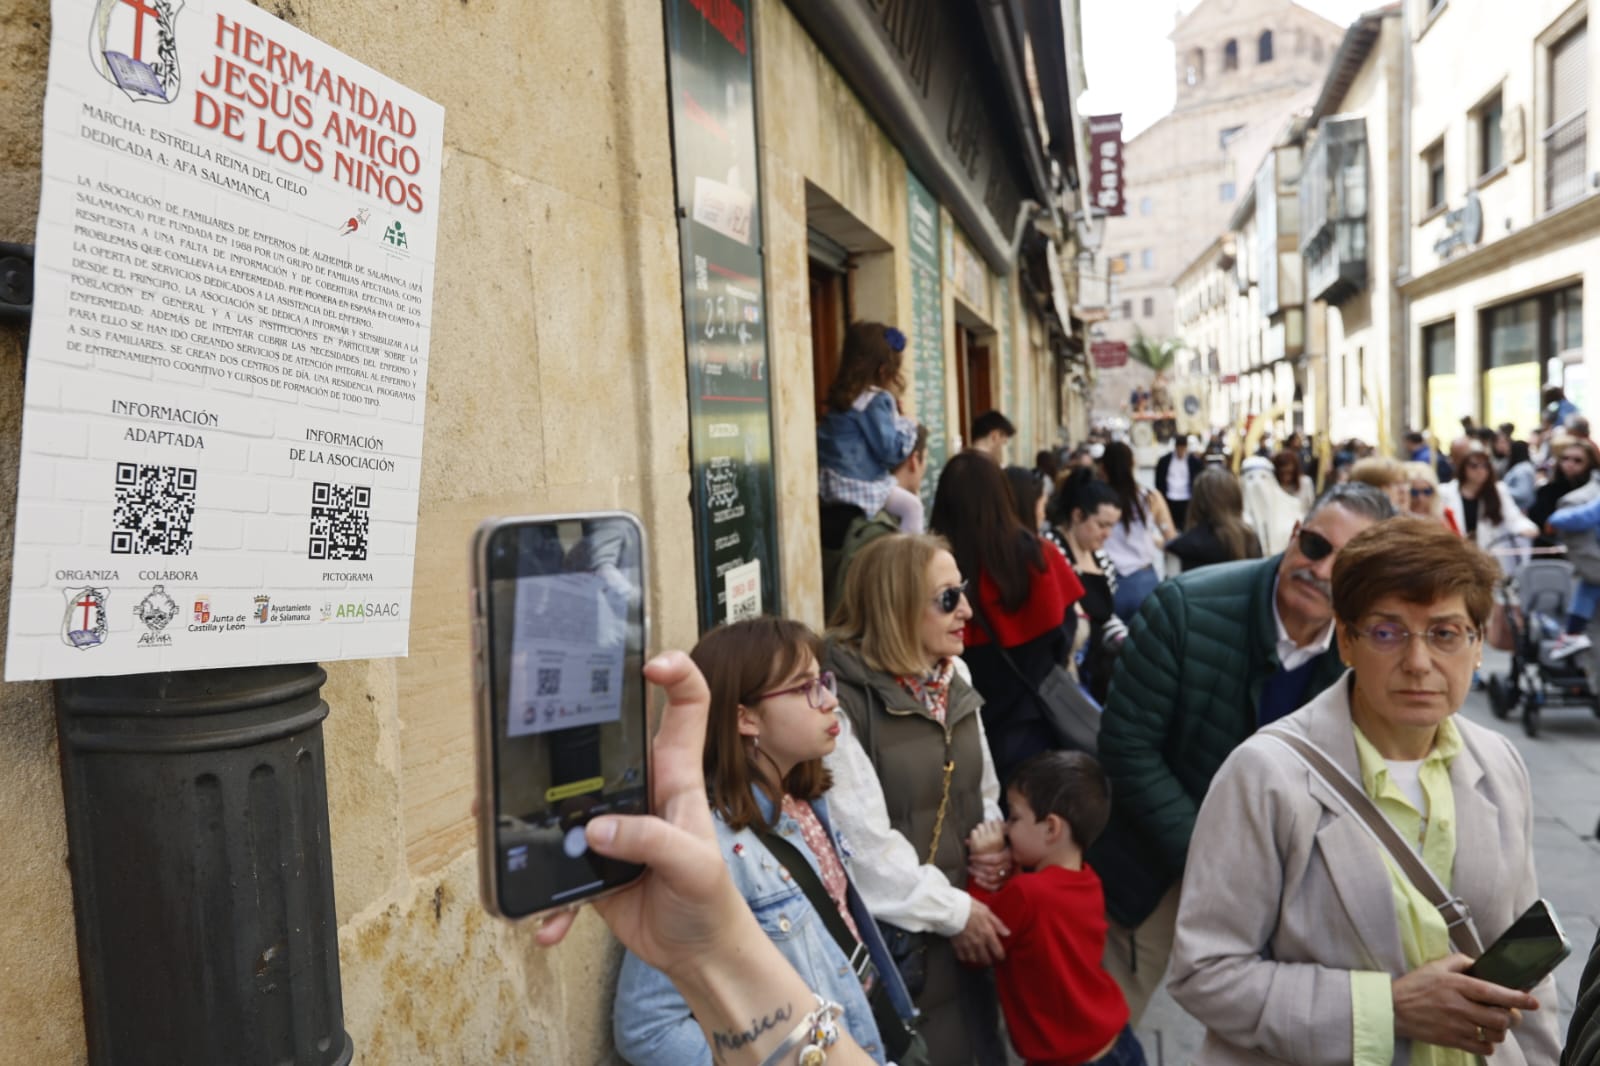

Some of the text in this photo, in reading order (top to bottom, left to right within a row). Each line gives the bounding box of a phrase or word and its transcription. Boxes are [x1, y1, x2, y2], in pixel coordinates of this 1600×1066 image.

[215, 13, 417, 138] HERMANDAD
[200, 55, 420, 176] JESÚS AMIGO
[80, 125, 270, 202] DEDICADA A: AFA SALAMANCA
[82, 103, 308, 196] MARCHA: ESTRELLA REINA DEL CIELO
[193, 90, 424, 214] DE LOS NIÑOS
[75, 206, 135, 233] RESPUESTA
[142, 227, 148, 237] A
[154, 230, 174, 244] UNA
[179, 237, 207, 254] FALTA
[213, 247, 224, 259] DE
[230, 252, 287, 277] INFORMACIÓN
[291, 270, 296, 279] Y
[77, 173, 90, 187] LA
[96, 180, 161, 209] ASOCIACIÓN
[165, 202, 178, 215] DE
[182, 207, 234, 232] FAMILIARES
[238, 225, 249, 237] DE
[253, 230, 296, 252] ENFERMOS
[300, 245, 309, 256] DE
[147, 212, 165, 226] FUE
[169, 219, 212, 240] FUNDADA
[216, 233, 227, 245] EN
[231, 238, 251, 252] 1988
[254, 245, 270, 258] POR
[273, 251, 284, 262] UN
[286, 255, 312, 271] GRUPO
[73, 240, 86, 253] LA
[90, 244, 131, 264] OFERTA
[134, 256, 147, 268] DE
[151, 261, 200, 282] SERVICIOS
[204, 275, 254, 296] DEDICADOS
[256, 289, 262, 298] A
[264, 291, 274, 302] LA
[277, 295, 320, 314] ASISTENCIA
[74, 223, 137, 250] PROBLEMAS
[140, 242, 161, 256] QUE
[165, 249, 213, 271] CONLLEVA
[216, 263, 226, 274] LA
[288, 284, 302, 295] FUE
[71, 273, 132, 297] POBLACIÓN
[141, 290, 154, 302] EN
[162, 295, 204, 314] GENERAL
[211, 307, 216, 316] Y
[224, 310, 230, 320] A
[237, 313, 252, 325] LAS
[259, 318, 317, 340] INSTITUCIONES
[72, 256, 108, 275] DESDE
[113, 267, 125, 279] EL
[185, 285, 196, 296] LA
[200, 289, 254, 311] ASOCIACIÓN
[258, 304, 268, 314] SE
[271, 307, 300, 322] DEDICA
[68, 306, 96, 321] PARA
[100, 313, 127, 328] ELLO
[130, 319, 143, 331] SE
[147, 323, 167, 336] HAN
[170, 328, 187, 340] IDO
[190, 332, 233, 350] CREANDO
[236, 342, 279, 359] SERVICIOS
[282, 352, 292, 362] DE
[295, 355, 332, 370] ATENCIÓN
[68, 323, 75, 334] A
[80, 325, 100, 339] SUS
[170, 343, 182, 355] SE
[185, 347, 215, 361] CREAN
[219, 353, 238, 365] DOS
[241, 358, 279, 373] CENTROS
[282, 366, 292, 376] DE
[151, 308, 189, 325] ADEMÁS
[194, 318, 207, 329] DE
[212, 322, 253, 340] INTENTAR
[258, 332, 287, 347] CUBRIR
[291, 340, 305, 351] LAS
[66, 340, 80, 352] DE
[84, 343, 170, 368] ENTRENAMIENTO
[173, 360, 224, 378] COGNITIVO
[227, 370, 232, 379] Y
[234, 371, 268, 386] CURSOS
[270, 378, 281, 388] DE
[283, 380, 328, 396] FORMACIÓN
[112, 400, 219, 426] INFORMACIÓN
[124, 427, 204, 449] ADAPTADA
[306, 428, 384, 450] INFORMACIÓN
[289, 448, 395, 472] DE LA ASOCIACIÓN
[55, 570, 374, 582] ORGANIZA COLABORA PICTOGRAMA
[188, 623, 217, 632] Castilla
[226, 622, 246, 630] León
[212, 614, 246, 623] Junta de
[270, 613, 311, 622] de Salamanca
[271, 604, 311, 612] Ayuntamiento
[336, 603, 400, 618] ARASAAC
